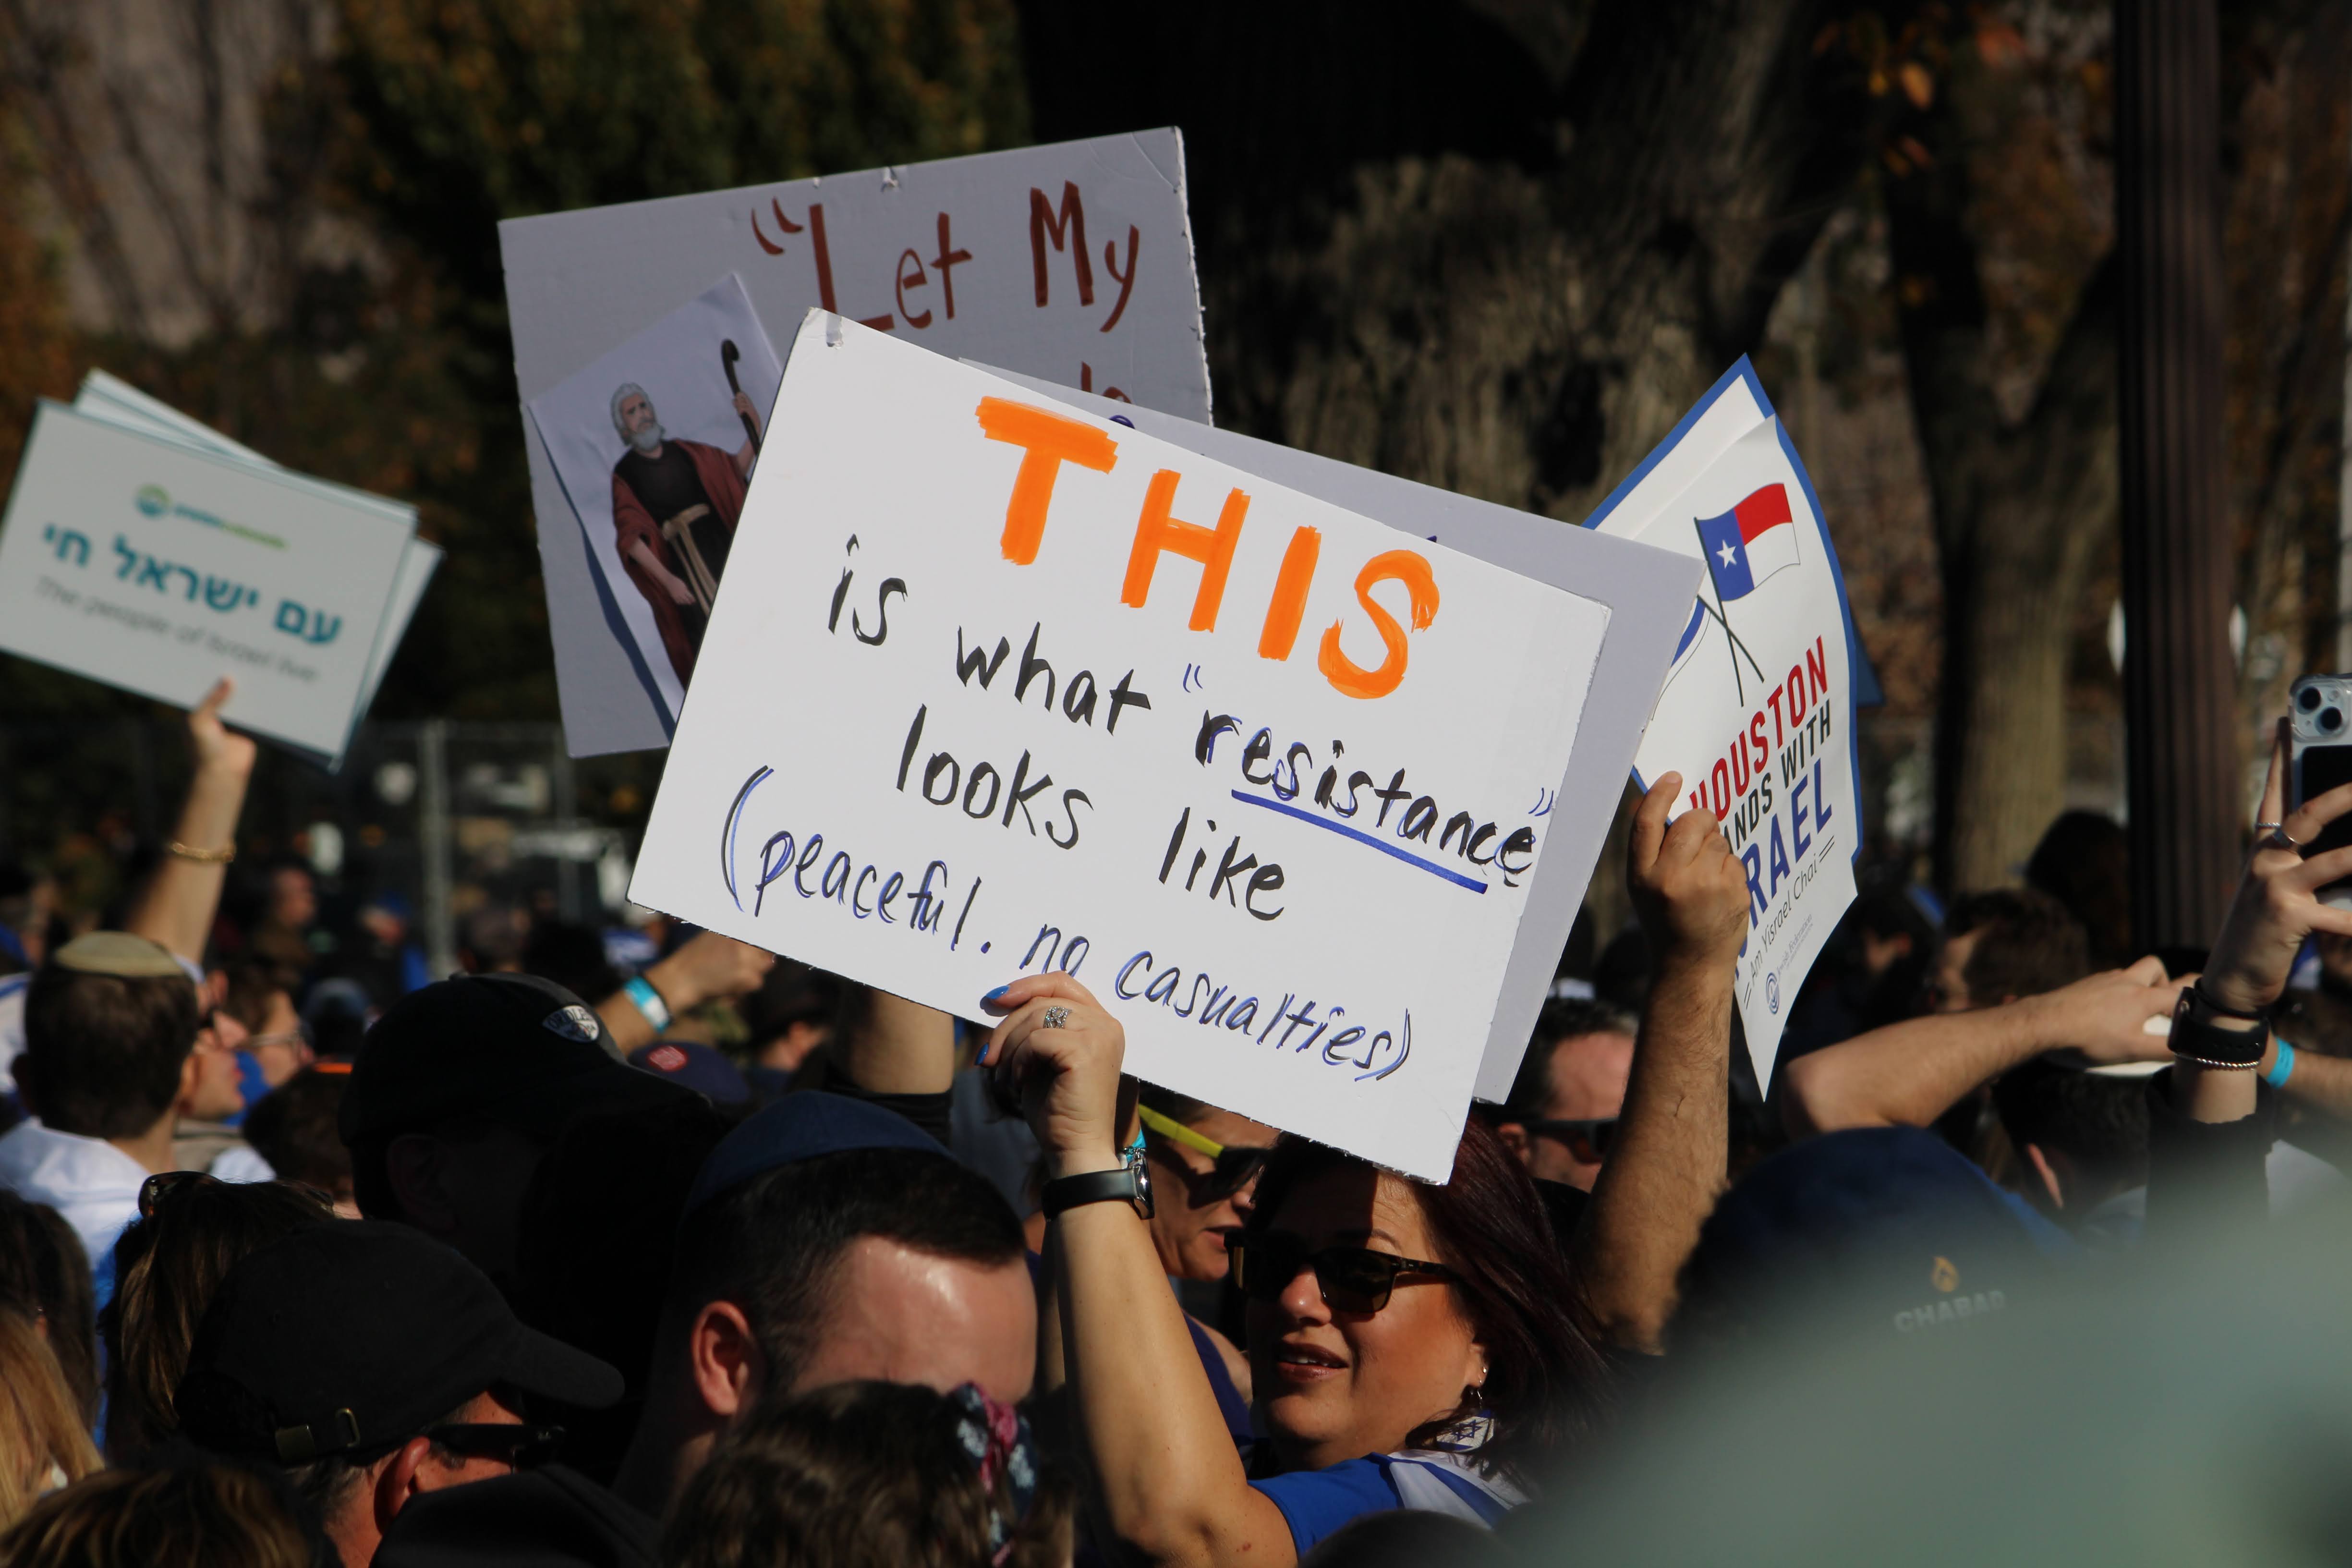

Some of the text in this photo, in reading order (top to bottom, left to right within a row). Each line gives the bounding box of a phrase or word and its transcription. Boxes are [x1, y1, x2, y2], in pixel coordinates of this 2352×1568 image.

[1030, 180, 1140, 332] My
[43, 523, 343, 644] עם ישראל חי
[975, 395, 1441, 700] THIS
[828, 534, 908, 646] is
[956, 621, 1152, 736] what
[896, 703, 1285, 921] looks like
[1781, 698, 1831, 789] WITH
[1750, 950, 1763, 987] Am
[1761, 889, 1792, 952] Yisrael
[1794, 853, 1818, 900] Chai
[1018, 923, 1090, 975] no
[1115, 950, 1411, 1082] casualties)
